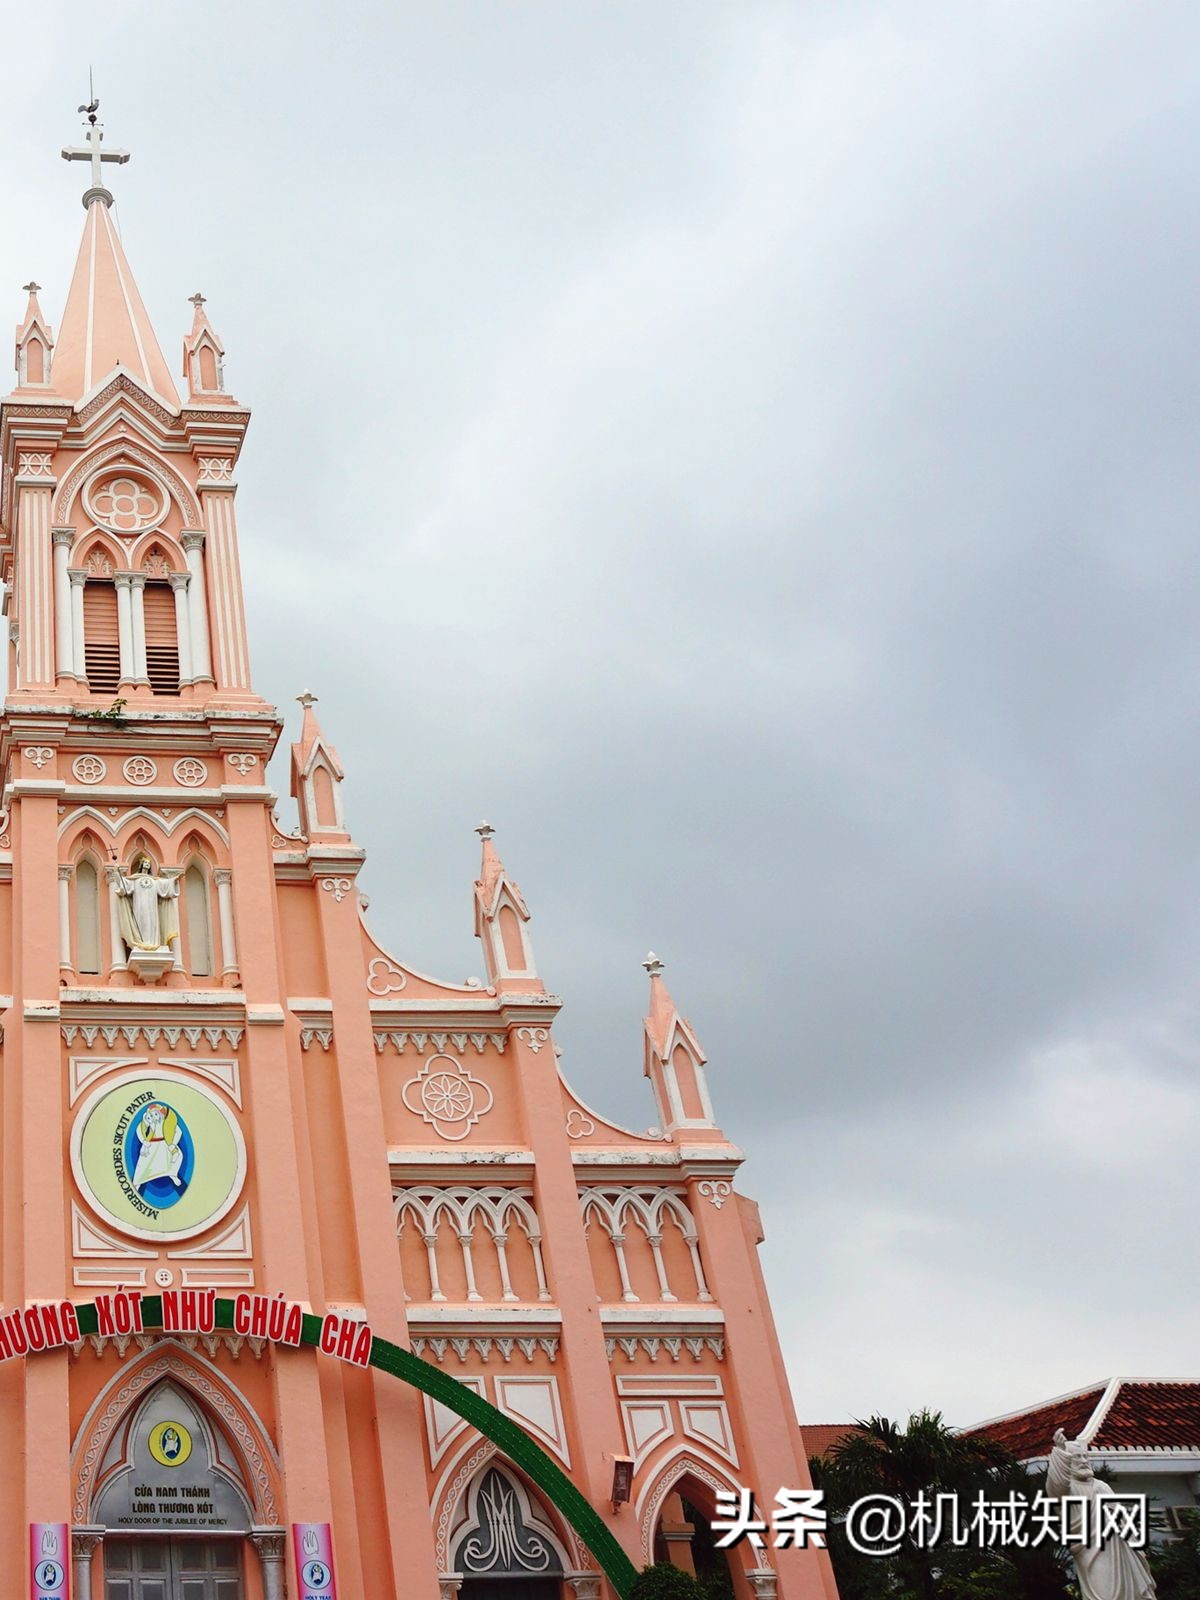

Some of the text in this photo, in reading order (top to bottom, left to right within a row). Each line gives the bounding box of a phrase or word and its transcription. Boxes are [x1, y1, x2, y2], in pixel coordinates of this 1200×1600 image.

[113, 1091, 160, 1221] MISERICORDES SICUT PATER
[95, 1284, 142, 1336] XÓT
[162, 1289, 216, 1333] NHƯ
[235, 1292, 301, 1345] CHÚA
[321, 1314, 371, 1366] CHA
